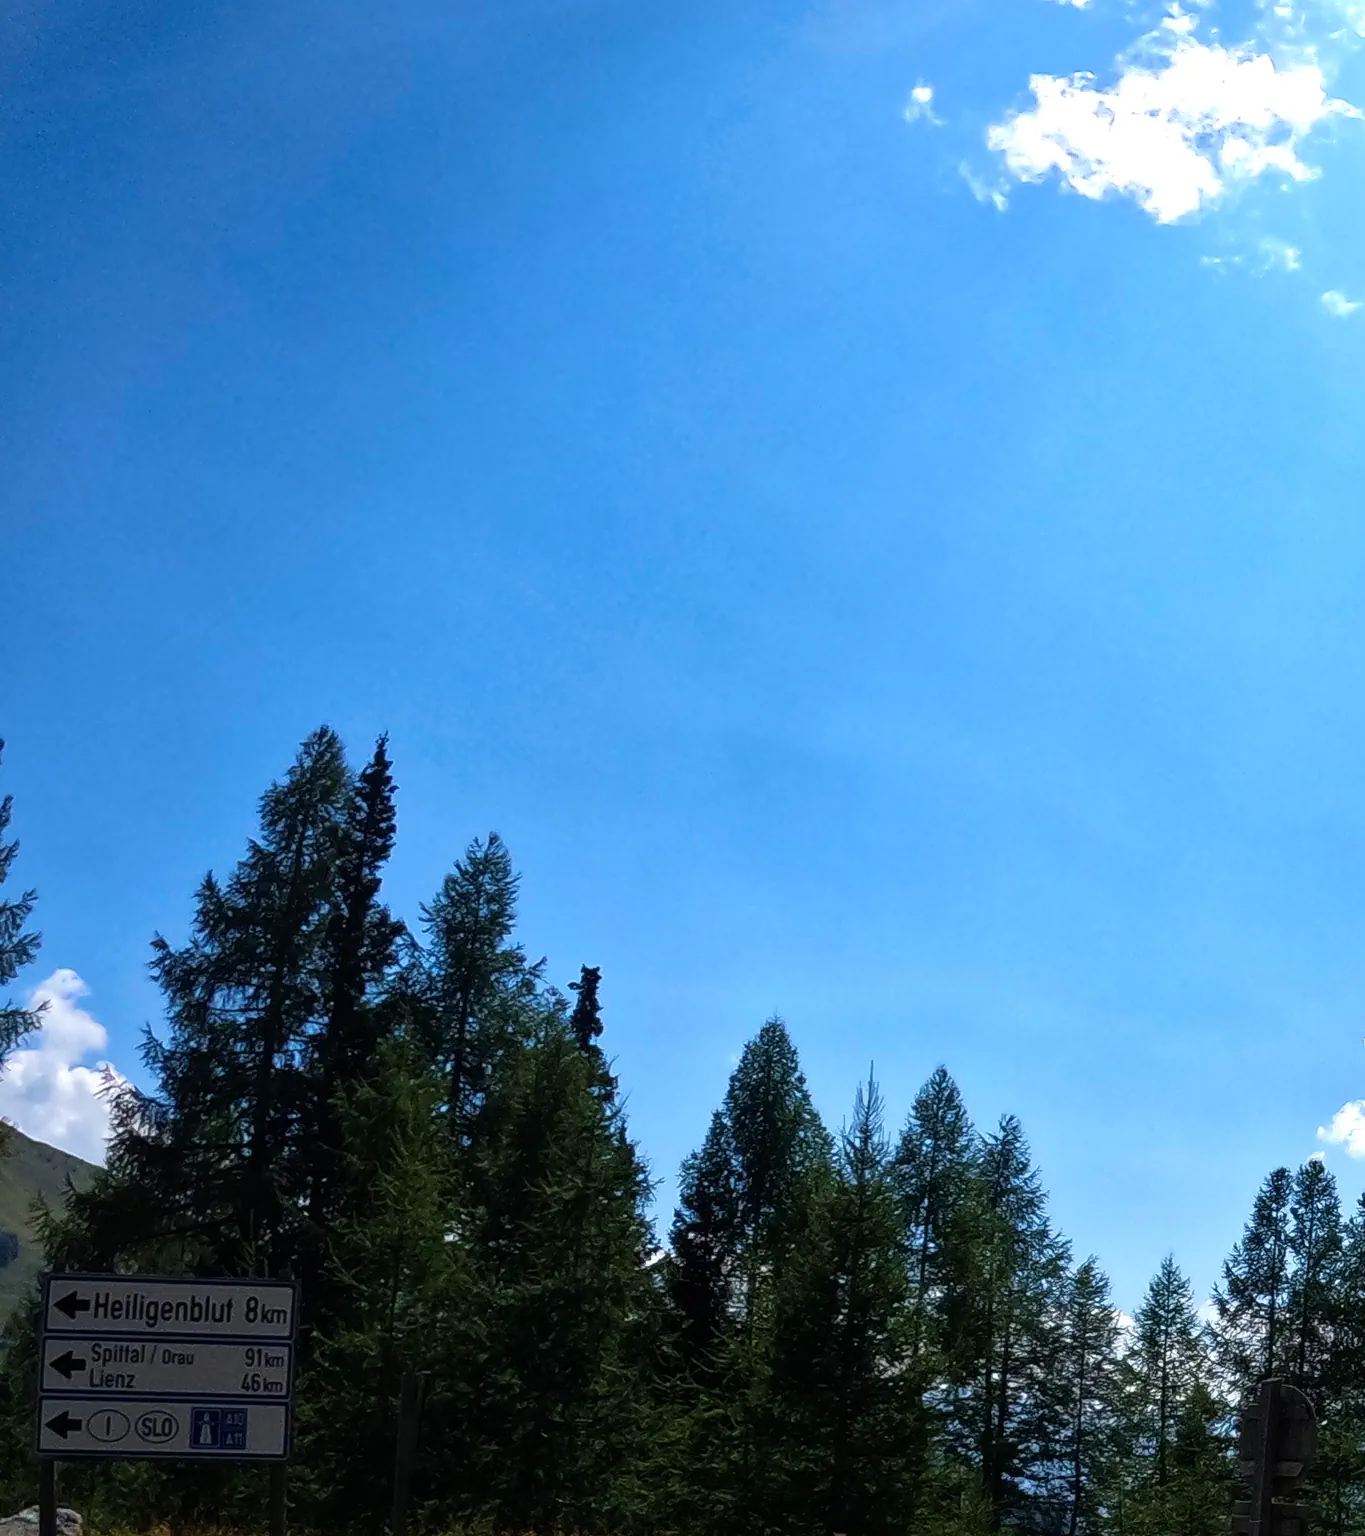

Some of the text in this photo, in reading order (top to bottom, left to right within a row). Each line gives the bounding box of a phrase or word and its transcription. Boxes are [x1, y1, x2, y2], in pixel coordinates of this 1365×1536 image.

[93, 1291, 288, 1328] Heiligenblut 8 km
[91, 1342, 146, 1367] Spittal
[161, 1348, 195, 1366] Drau
[244, 1349, 262, 1368] 91
[264, 1352, 285, 1369] km
[89, 1370, 284, 1393] Lienz 46 km
[140, 1417, 173, 1438] SLO
